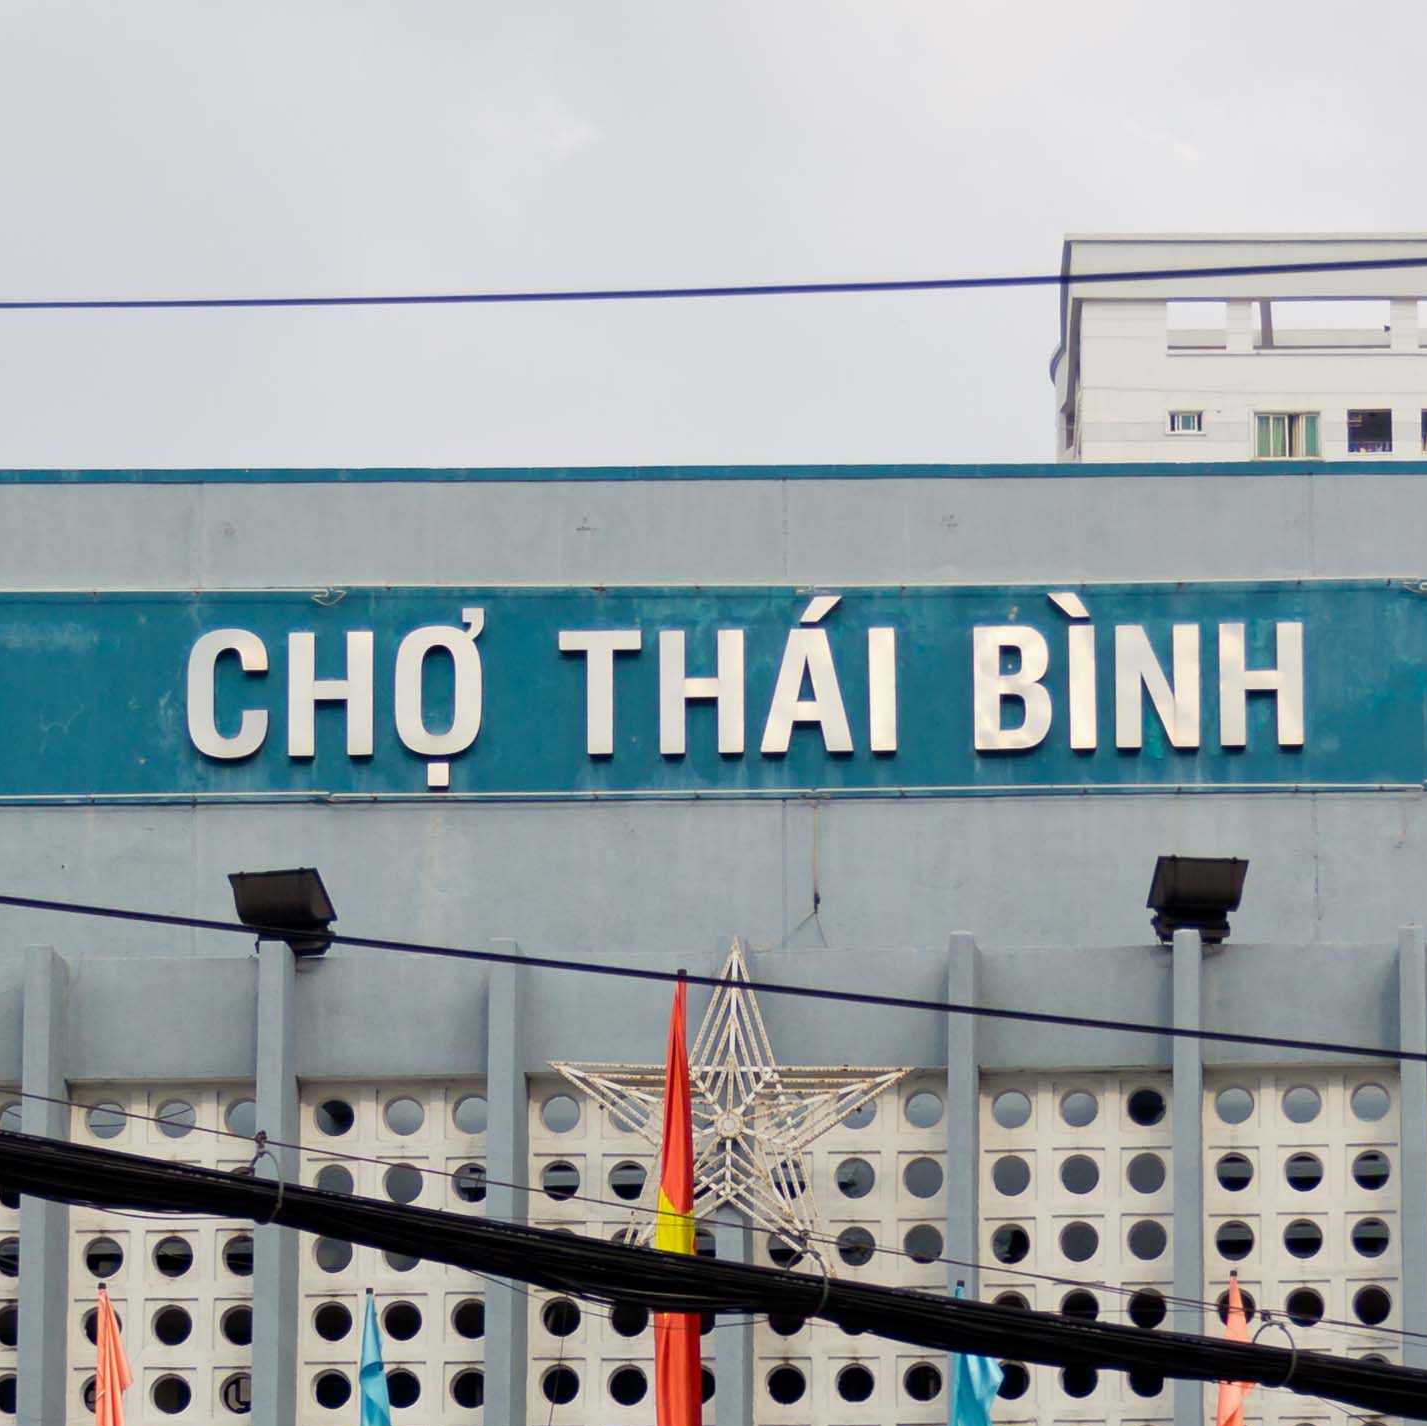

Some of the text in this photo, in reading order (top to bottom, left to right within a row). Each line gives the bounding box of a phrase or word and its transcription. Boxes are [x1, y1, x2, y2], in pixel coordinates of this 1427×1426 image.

[186, 590, 1306, 788] CHỢ THÁI BÌNH
